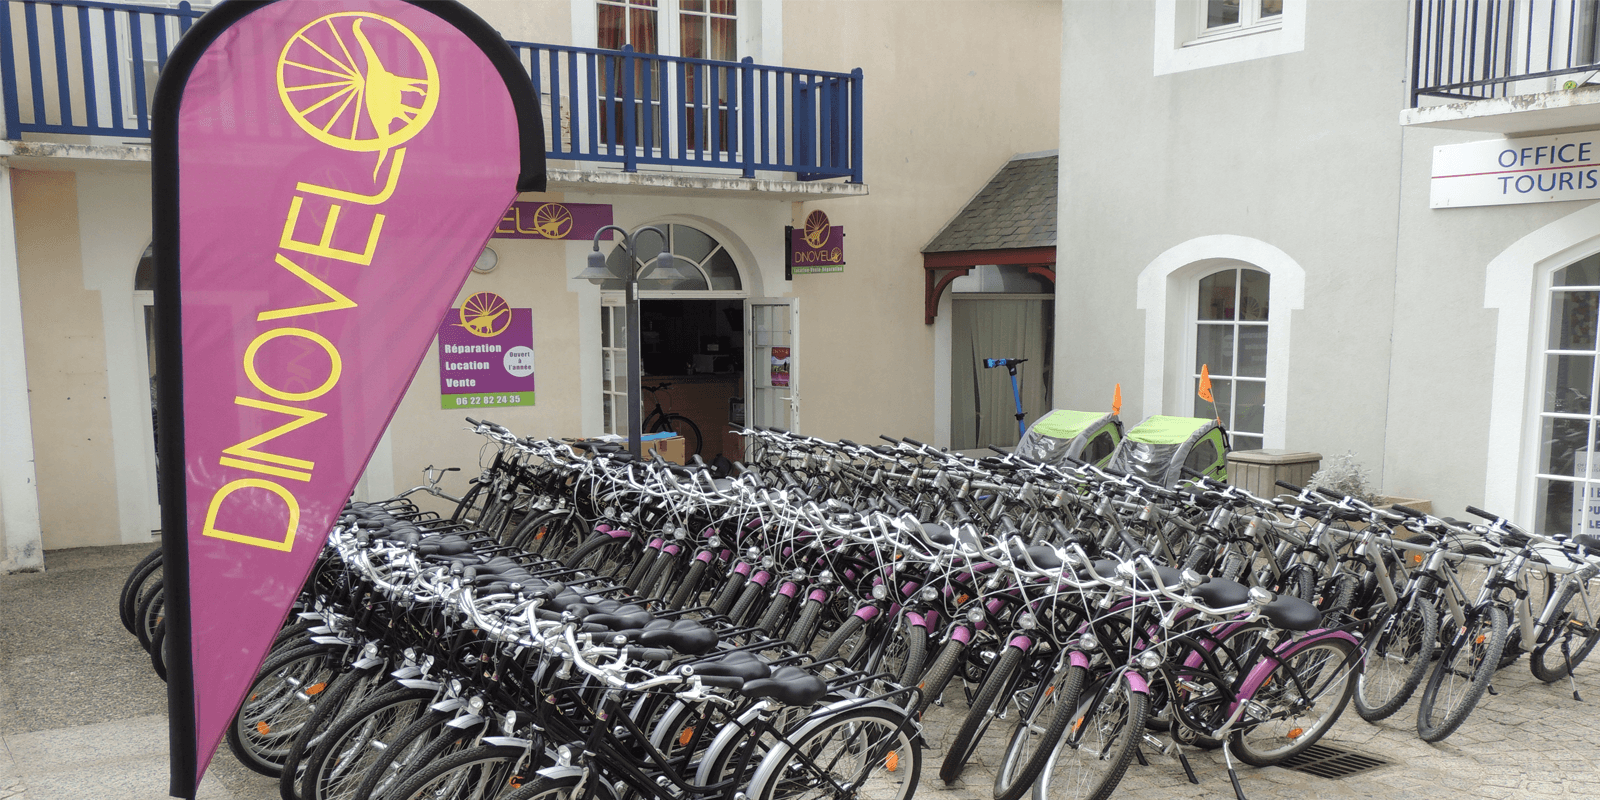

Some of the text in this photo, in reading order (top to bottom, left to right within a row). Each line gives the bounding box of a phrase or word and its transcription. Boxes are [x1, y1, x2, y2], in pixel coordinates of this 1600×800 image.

[1498, 142, 1592, 168] OFFICE
[1498, 170, 1598, 194] TOURIS
[444, 344, 502, 354] Réparation
[445, 361, 490, 370] Location
[446, 378, 476, 387] Vente
[456, 395, 521, 405] 06 22 82 24 35
